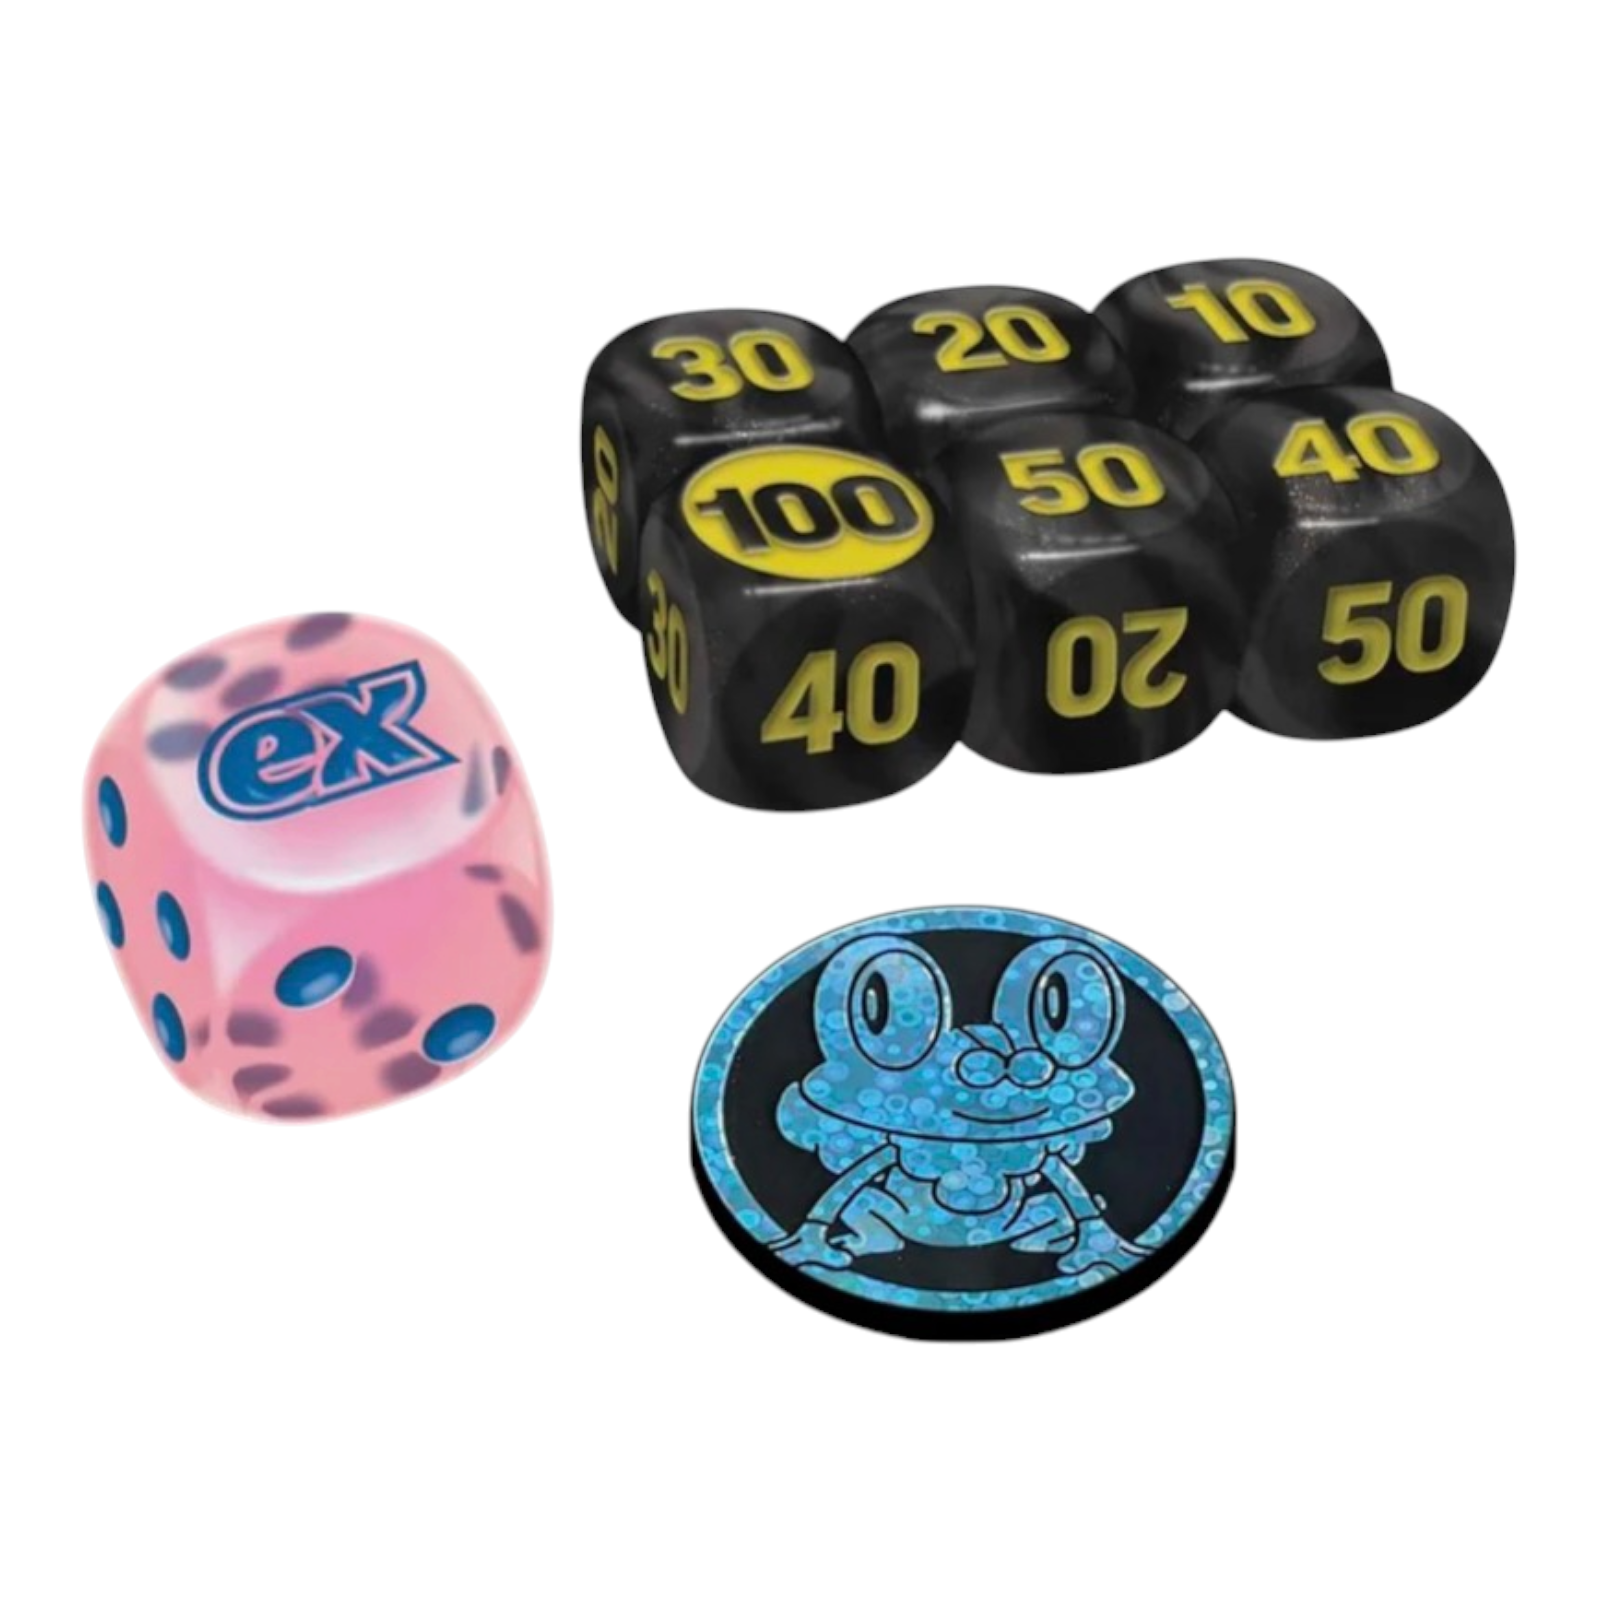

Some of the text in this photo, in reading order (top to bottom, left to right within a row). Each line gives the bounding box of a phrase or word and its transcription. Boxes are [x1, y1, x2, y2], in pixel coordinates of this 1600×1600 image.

[911, 307, 1072, 374] 20
[1167, 280, 1315, 346] 10
[650, 329, 815, 402] 30
[1000, 443, 1166, 518] 50
[1271, 410, 1441, 485] 40
[695, 475, 923, 556] 100
[646, 568, 690, 716] 30
[1318, 574, 1471, 687] 50
[760, 640, 922, 756] 40
[197, 659, 461, 821] ex
